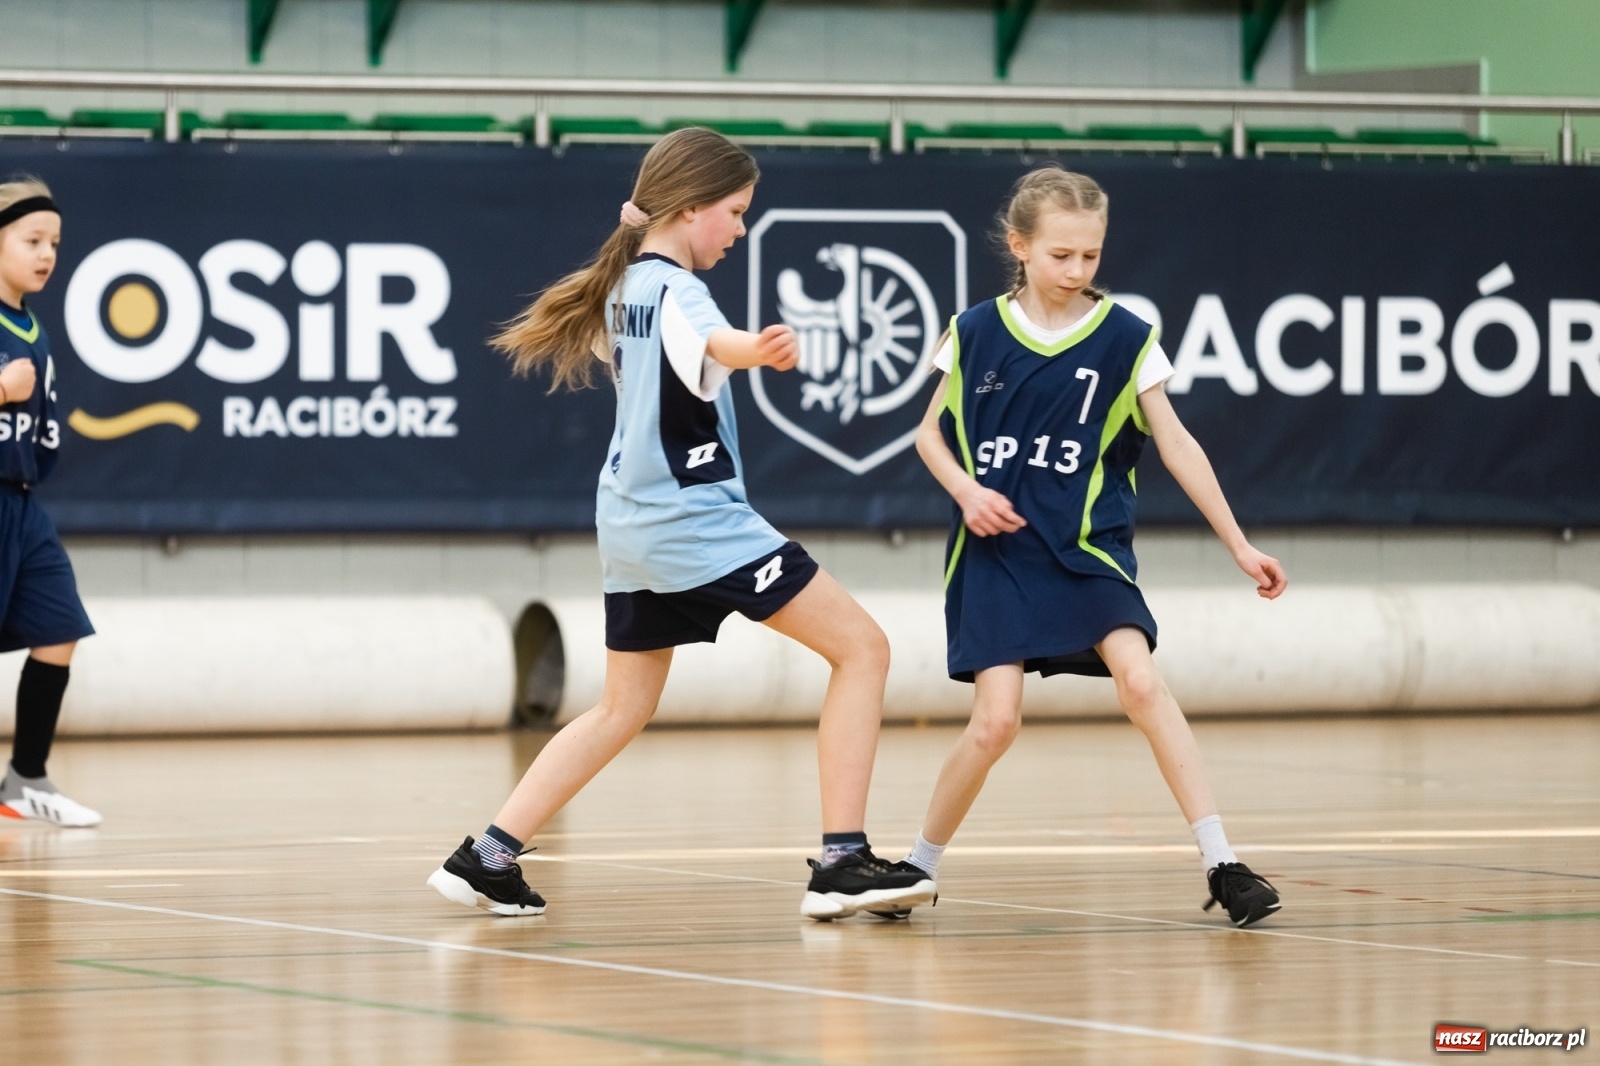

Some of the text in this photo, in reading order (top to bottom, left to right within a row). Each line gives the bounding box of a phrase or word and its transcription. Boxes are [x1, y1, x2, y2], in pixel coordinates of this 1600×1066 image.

[64, 237, 458, 384] OSiR
[222, 385, 459, 437] RACIBÓRZ
[1074, 367, 1100, 425] 7
[0, 412, 32, 442] SP
[975, 434, 1082, 476] SP 13
